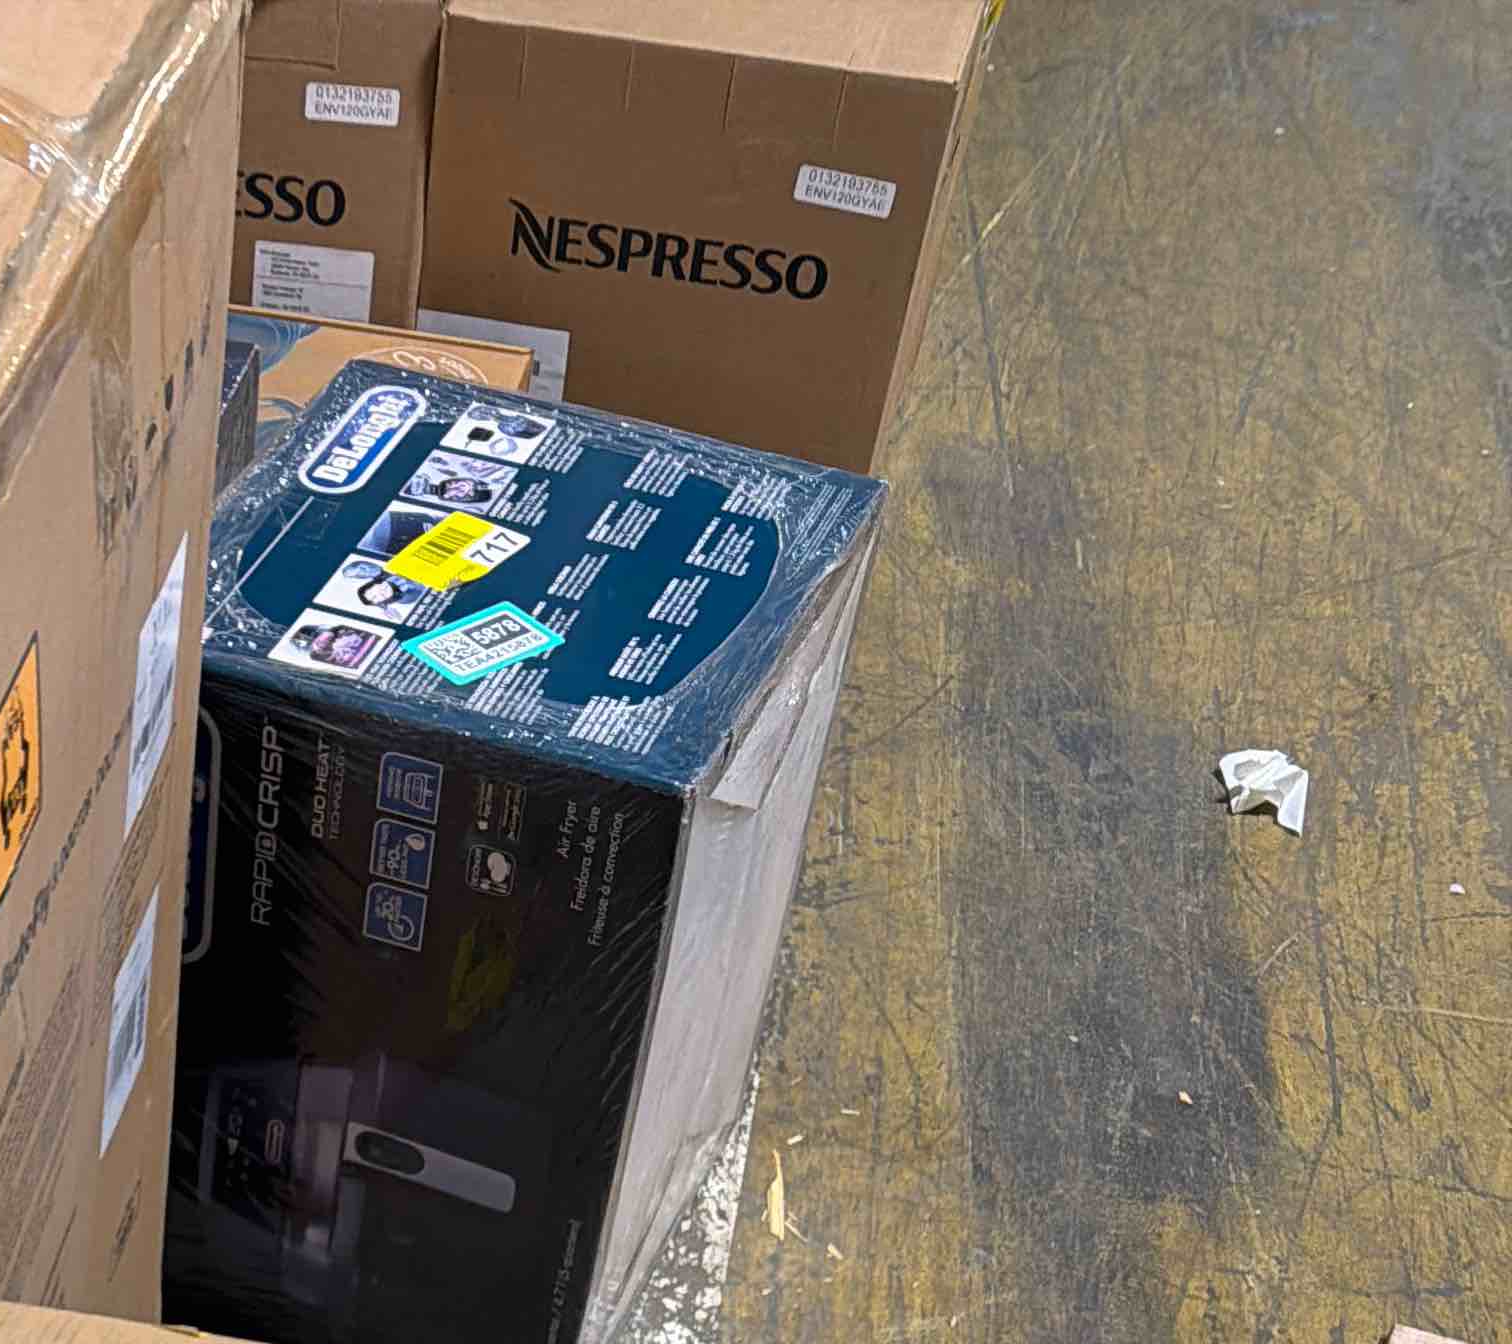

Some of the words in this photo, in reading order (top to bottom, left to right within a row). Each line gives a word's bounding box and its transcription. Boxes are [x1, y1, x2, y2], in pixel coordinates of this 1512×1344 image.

[508, 197, 829, 300] NESPRESSO
[469, 531, 518, 564] 717
[470, 618, 523, 648] 5878
[315, 738, 332, 791] HEAT
[310, 792, 328, 839] DUO
[560, 800, 578, 835] Fryer
[570, 857, 593, 911] Freidora
